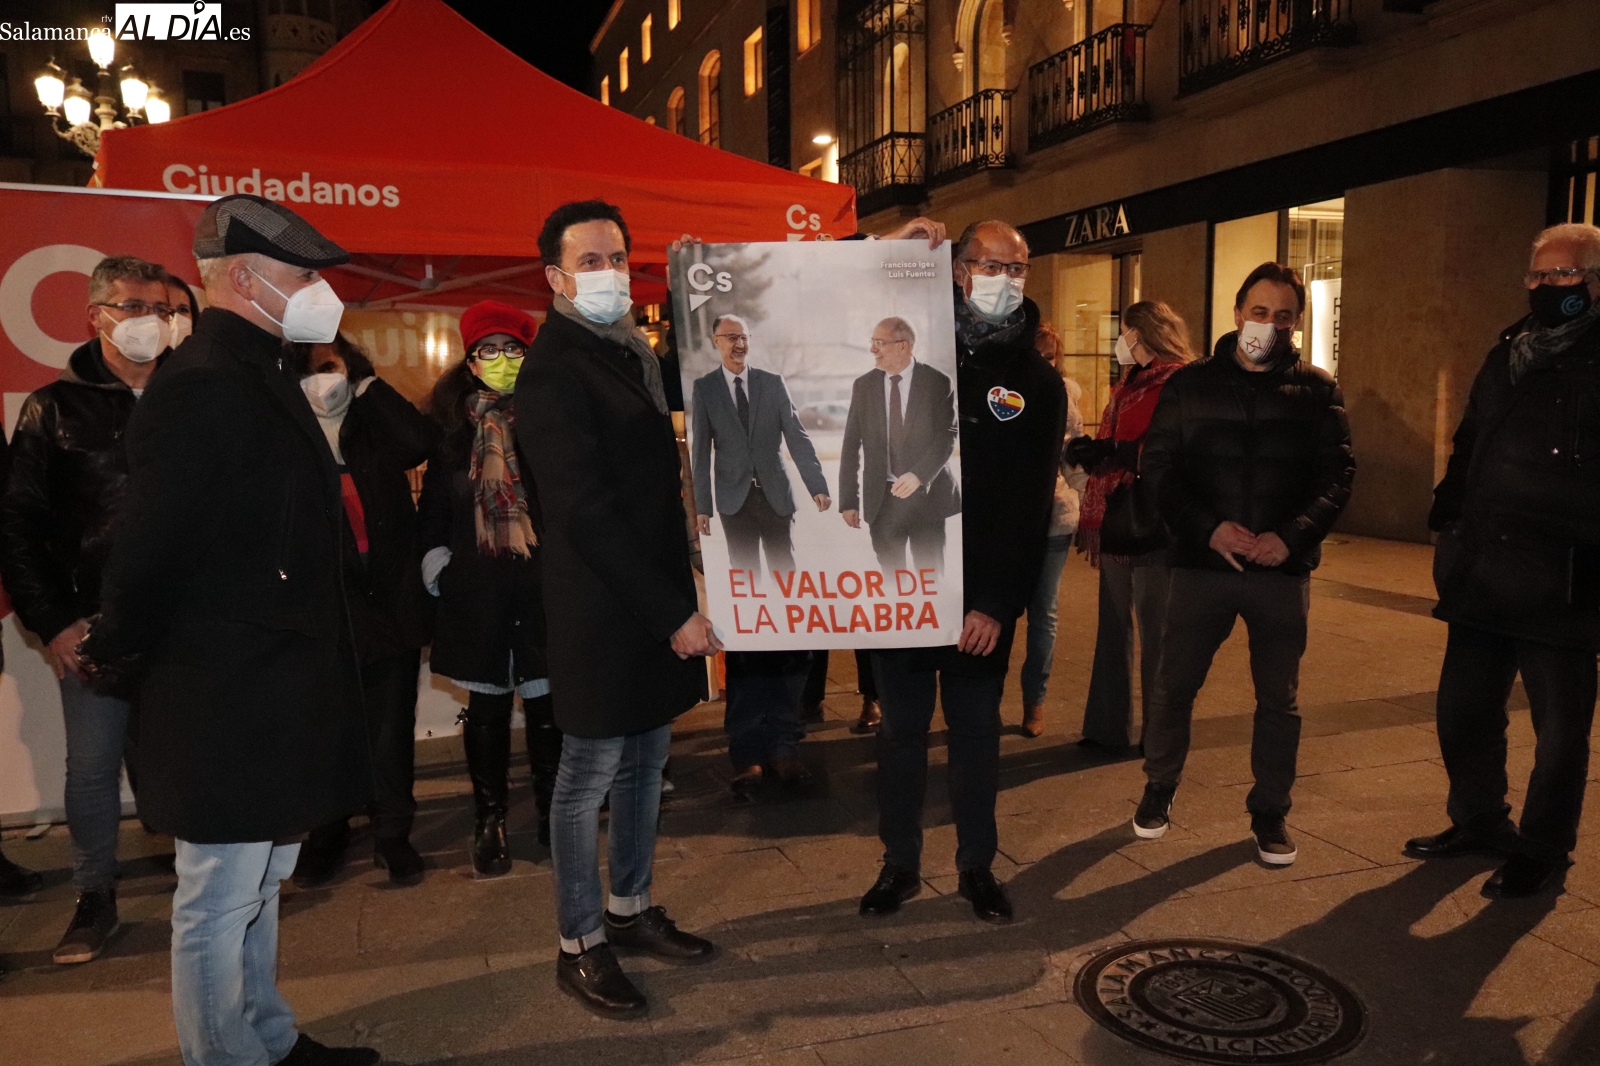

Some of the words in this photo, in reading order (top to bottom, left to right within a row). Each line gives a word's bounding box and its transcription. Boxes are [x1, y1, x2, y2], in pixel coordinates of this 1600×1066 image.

[162, 163, 400, 208] Ciudadanos
[785, 204, 821, 232] Cs
[1064, 204, 1131, 248] ZARA
[687, 263, 733, 293] Cs
[880, 261, 917, 270] Francisco
[919, 261, 935, 271] Igea
[888, 270, 904, 279] Luis
[906, 270, 936, 278] Fuentes
[728, 569, 767, 598] EL
[773, 569, 886, 599] VALOR
[895, 568, 938, 596] DE
[733, 604, 778, 633] LA
[786, 602, 939, 633] PALABRA
[1098, 948, 1243, 1020] SALAMANCA
[1183, 973, 1341, 1056] ALCANTARILLADO
